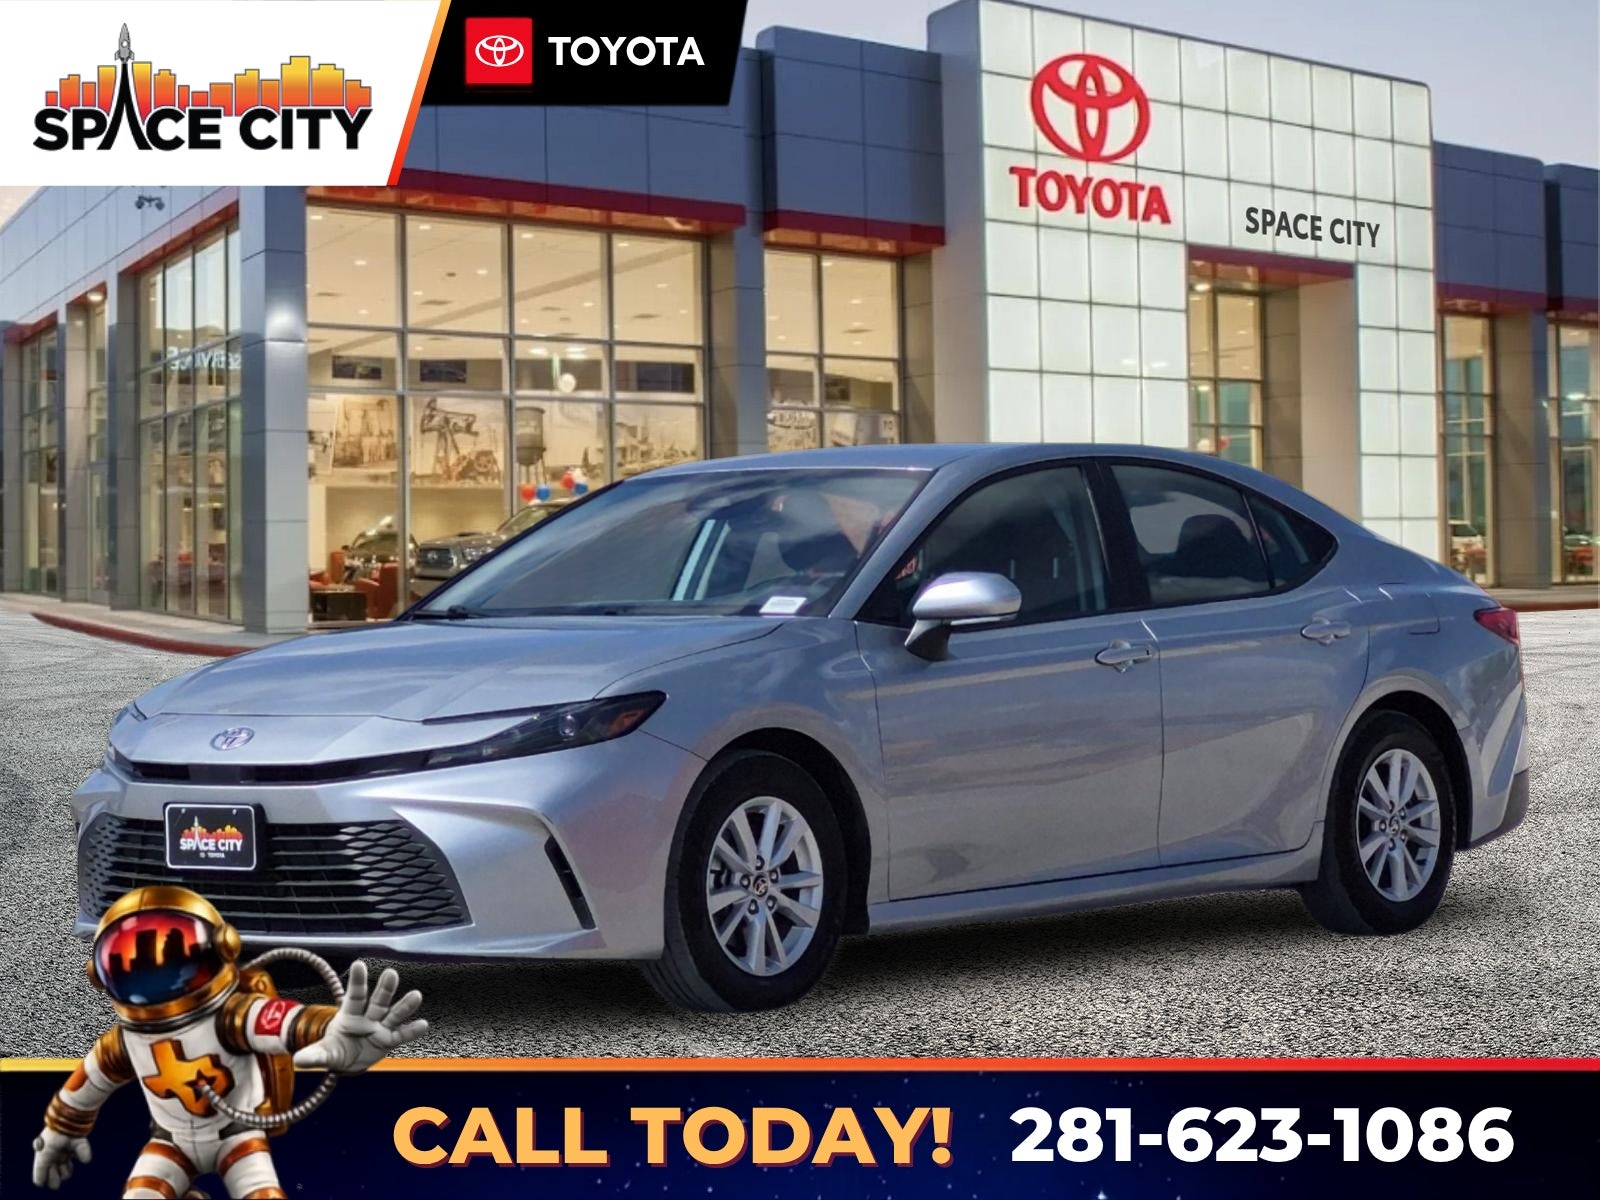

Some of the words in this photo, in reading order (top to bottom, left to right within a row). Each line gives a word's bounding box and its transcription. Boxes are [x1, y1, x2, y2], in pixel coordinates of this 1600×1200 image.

[1009, 166, 1171, 224] TOYOTA
[1246, 206, 1322, 241] SPACE
[1329, 218, 1381, 248] CITY
[179, 838, 216, 851] SPACE
[217, 838, 243, 852] CITY
